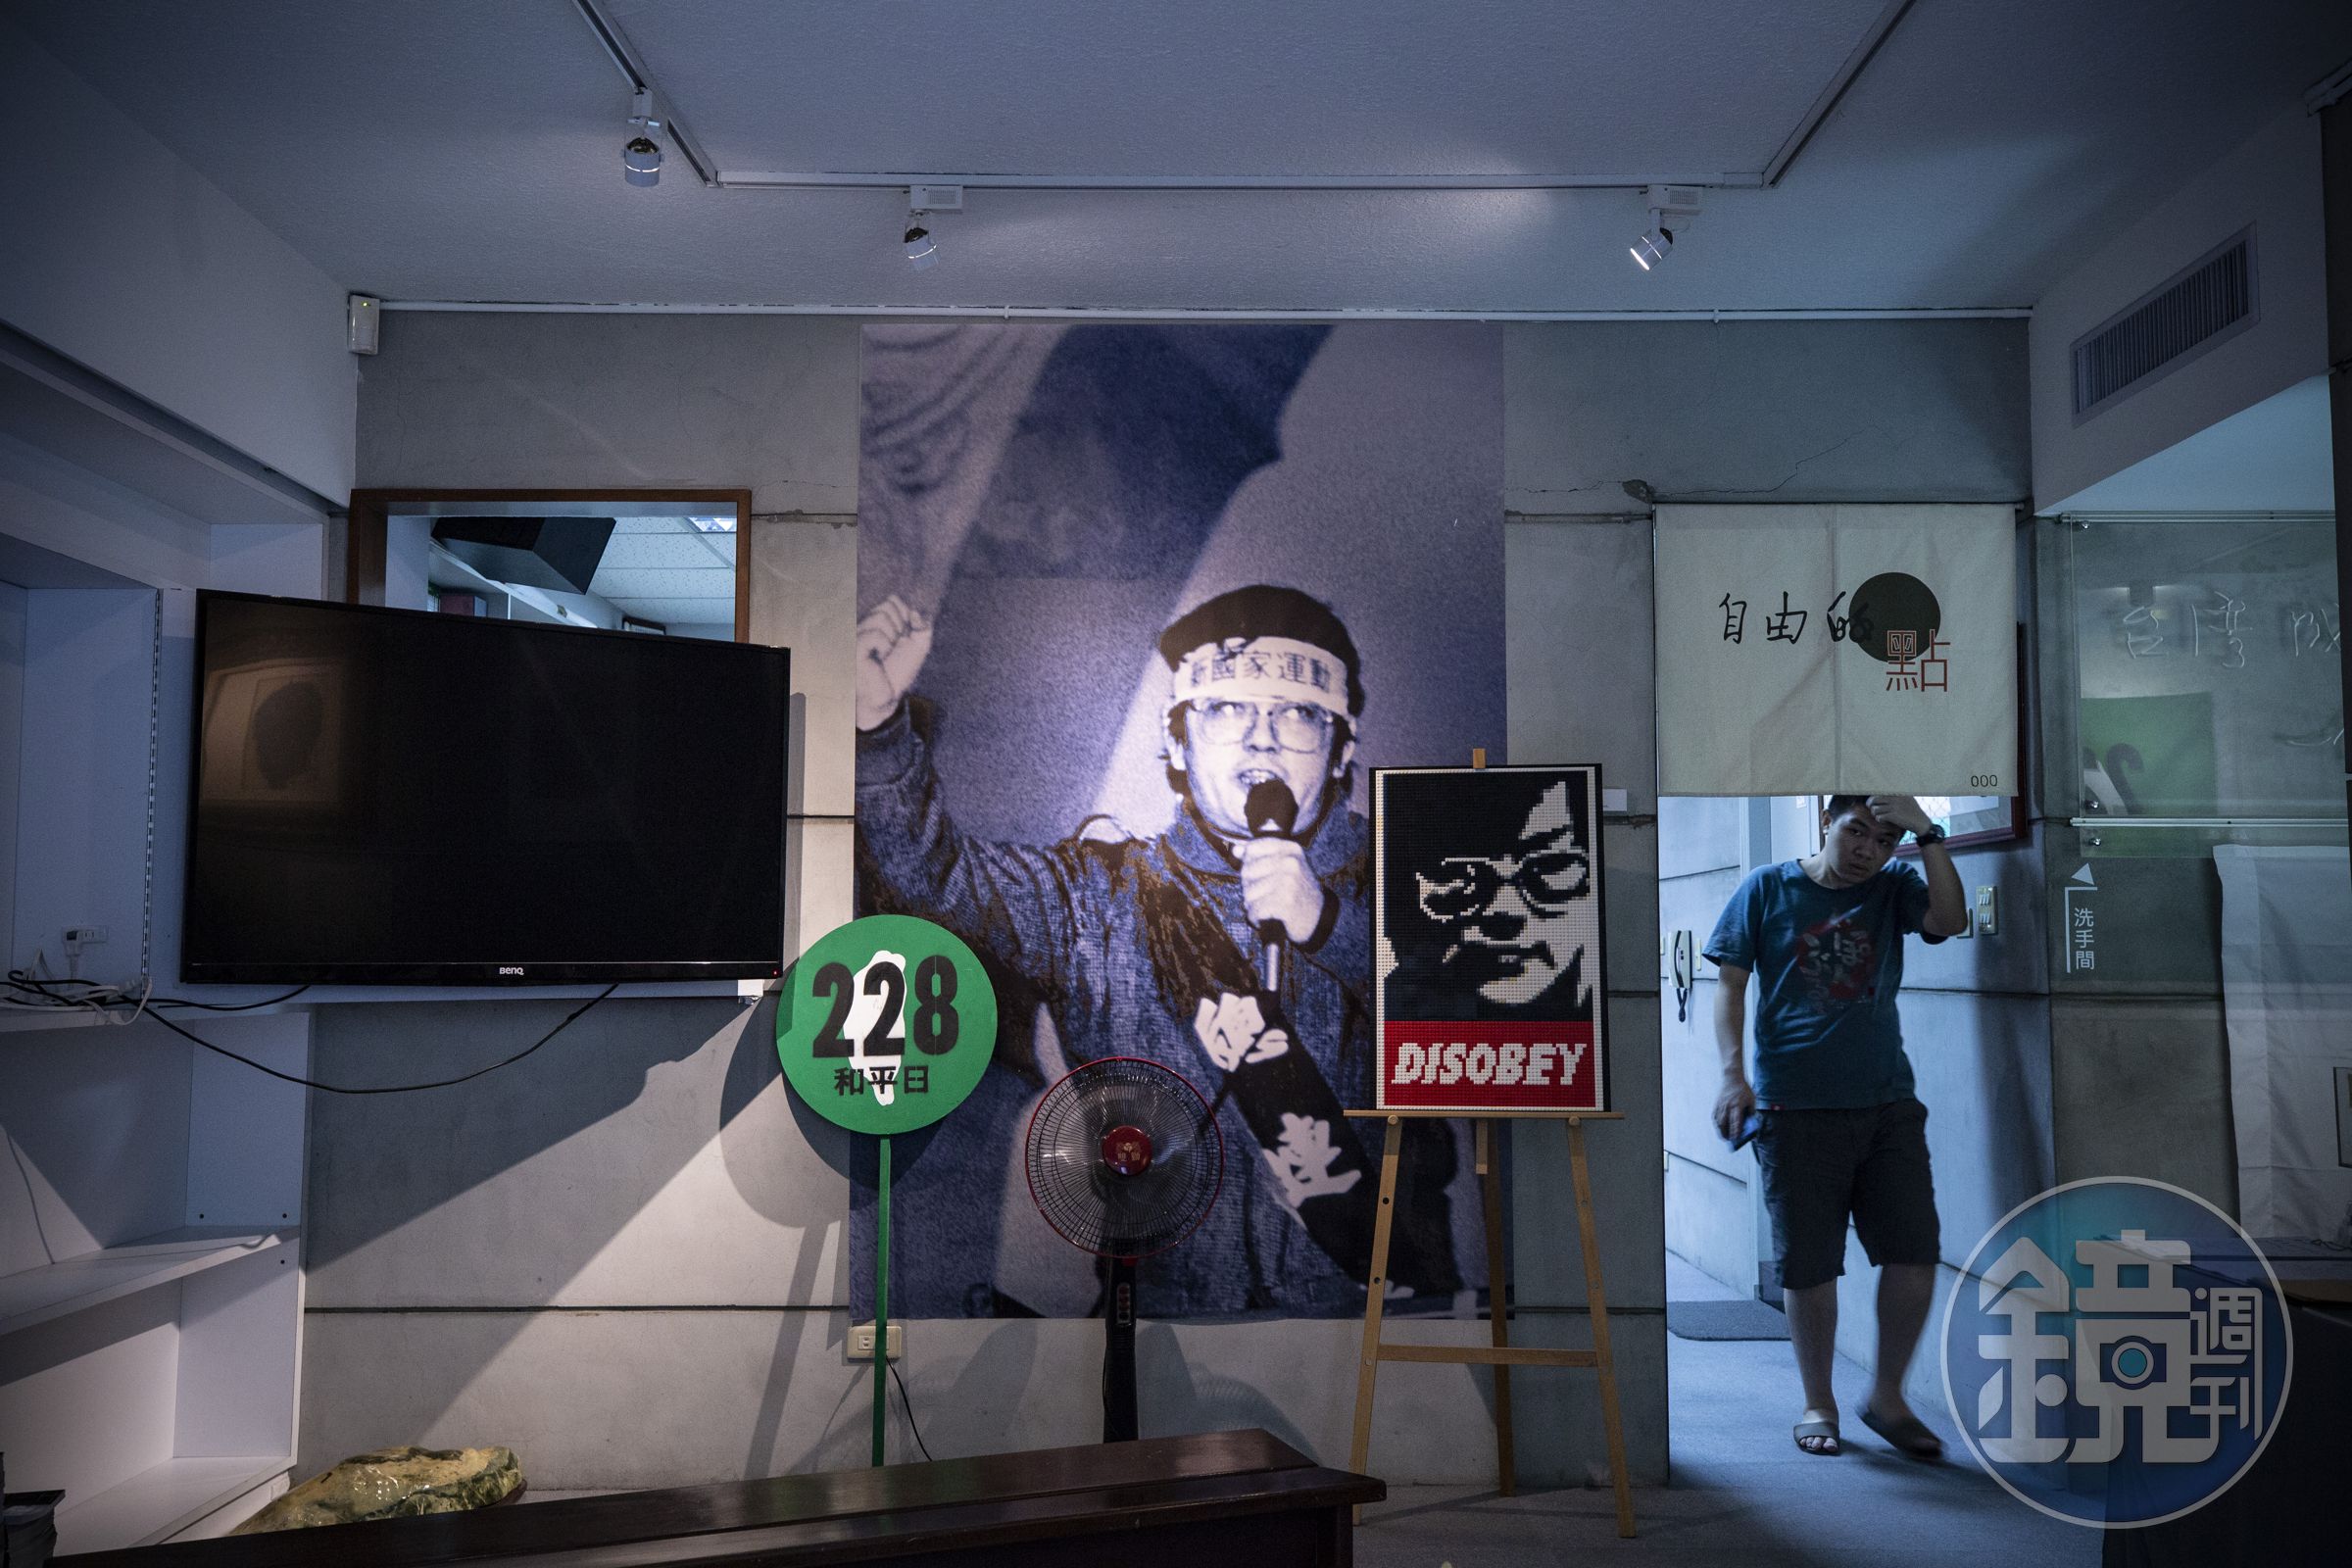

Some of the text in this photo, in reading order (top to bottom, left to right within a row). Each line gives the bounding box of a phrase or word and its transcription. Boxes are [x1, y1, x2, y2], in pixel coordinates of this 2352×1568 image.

[2074, 906, 2095, 970] 洗手間
[499, 966, 524, 976] BenQ
[812, 955, 959, 1058] 228
[833, 1064, 929, 1096] 和平日
[1391, 1043, 1588, 1086] DISOBEY
